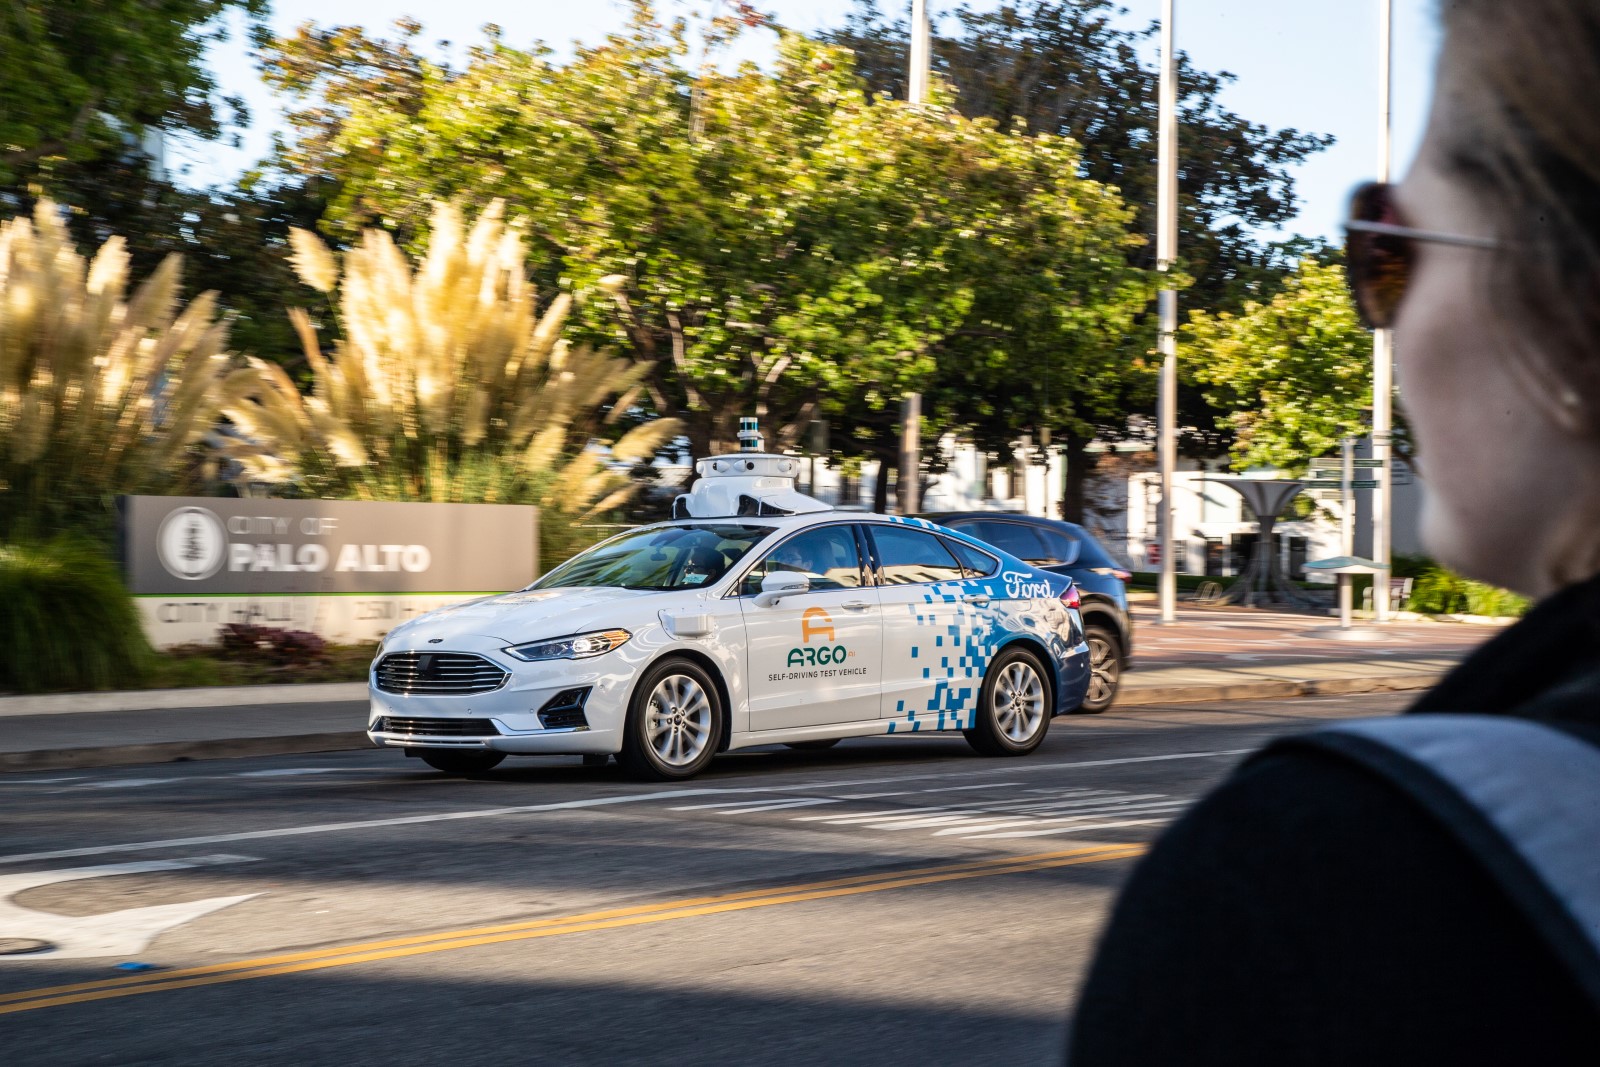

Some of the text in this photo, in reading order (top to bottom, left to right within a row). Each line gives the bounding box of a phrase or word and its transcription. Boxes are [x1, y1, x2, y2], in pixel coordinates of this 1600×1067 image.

[227, 516, 340, 536] CITY OF
[228, 543, 431, 573] PALO ALTO
[1002, 571, 1055, 598] Ford
[156, 602, 220, 623] CITY
[787, 645, 847, 667] ARGO
[768, 671, 818, 681] SELF-DRIVING
[839, 667, 867, 676] VEHICLE
